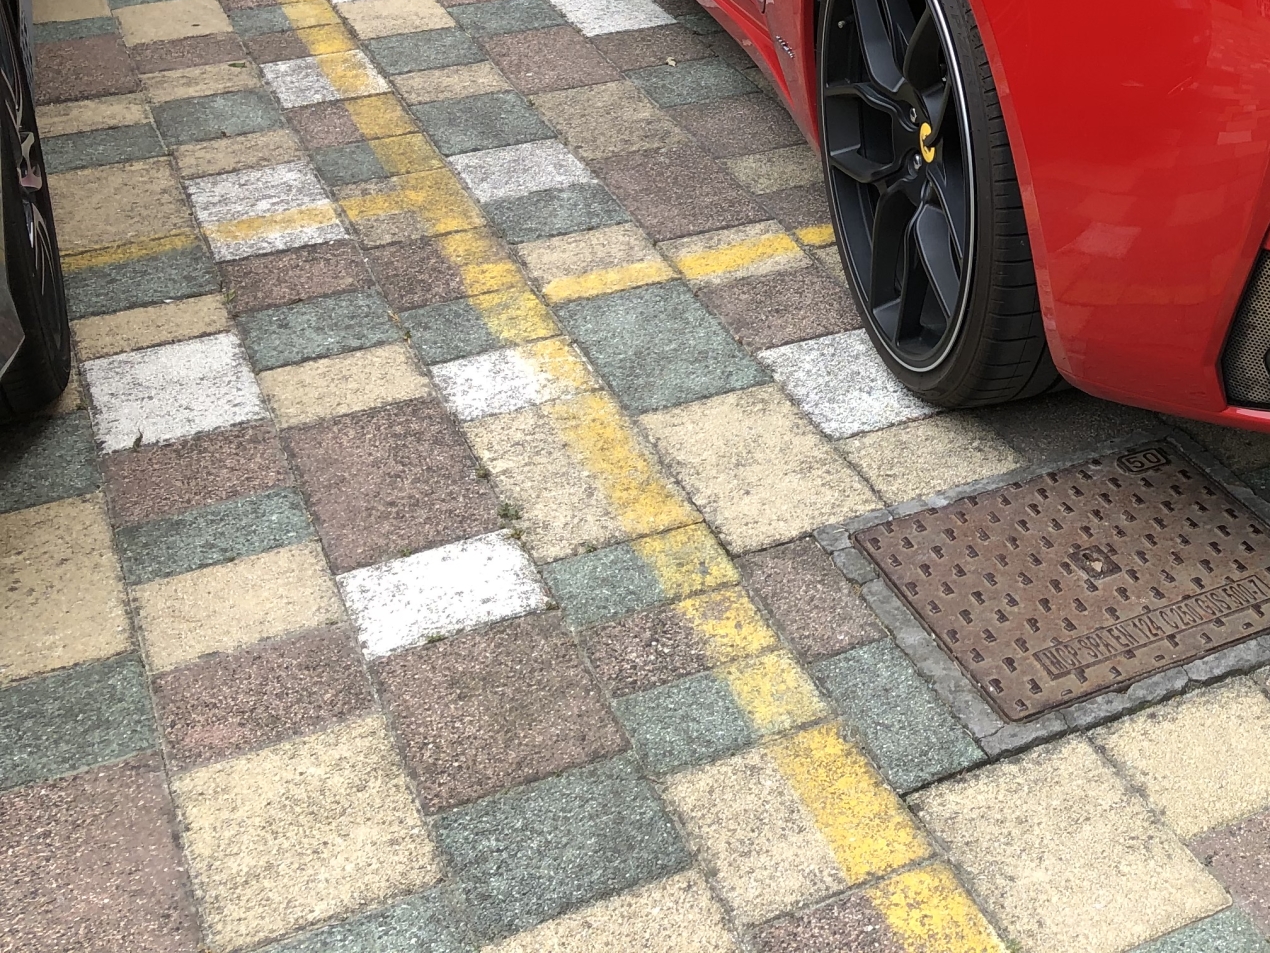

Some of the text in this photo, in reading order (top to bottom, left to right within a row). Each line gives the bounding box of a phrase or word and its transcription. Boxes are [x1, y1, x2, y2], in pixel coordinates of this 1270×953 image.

[1125, 452, 1162, 469] 50
[1108, 624, 1140, 649] EN
[1132, 616, 1166, 640] 124
